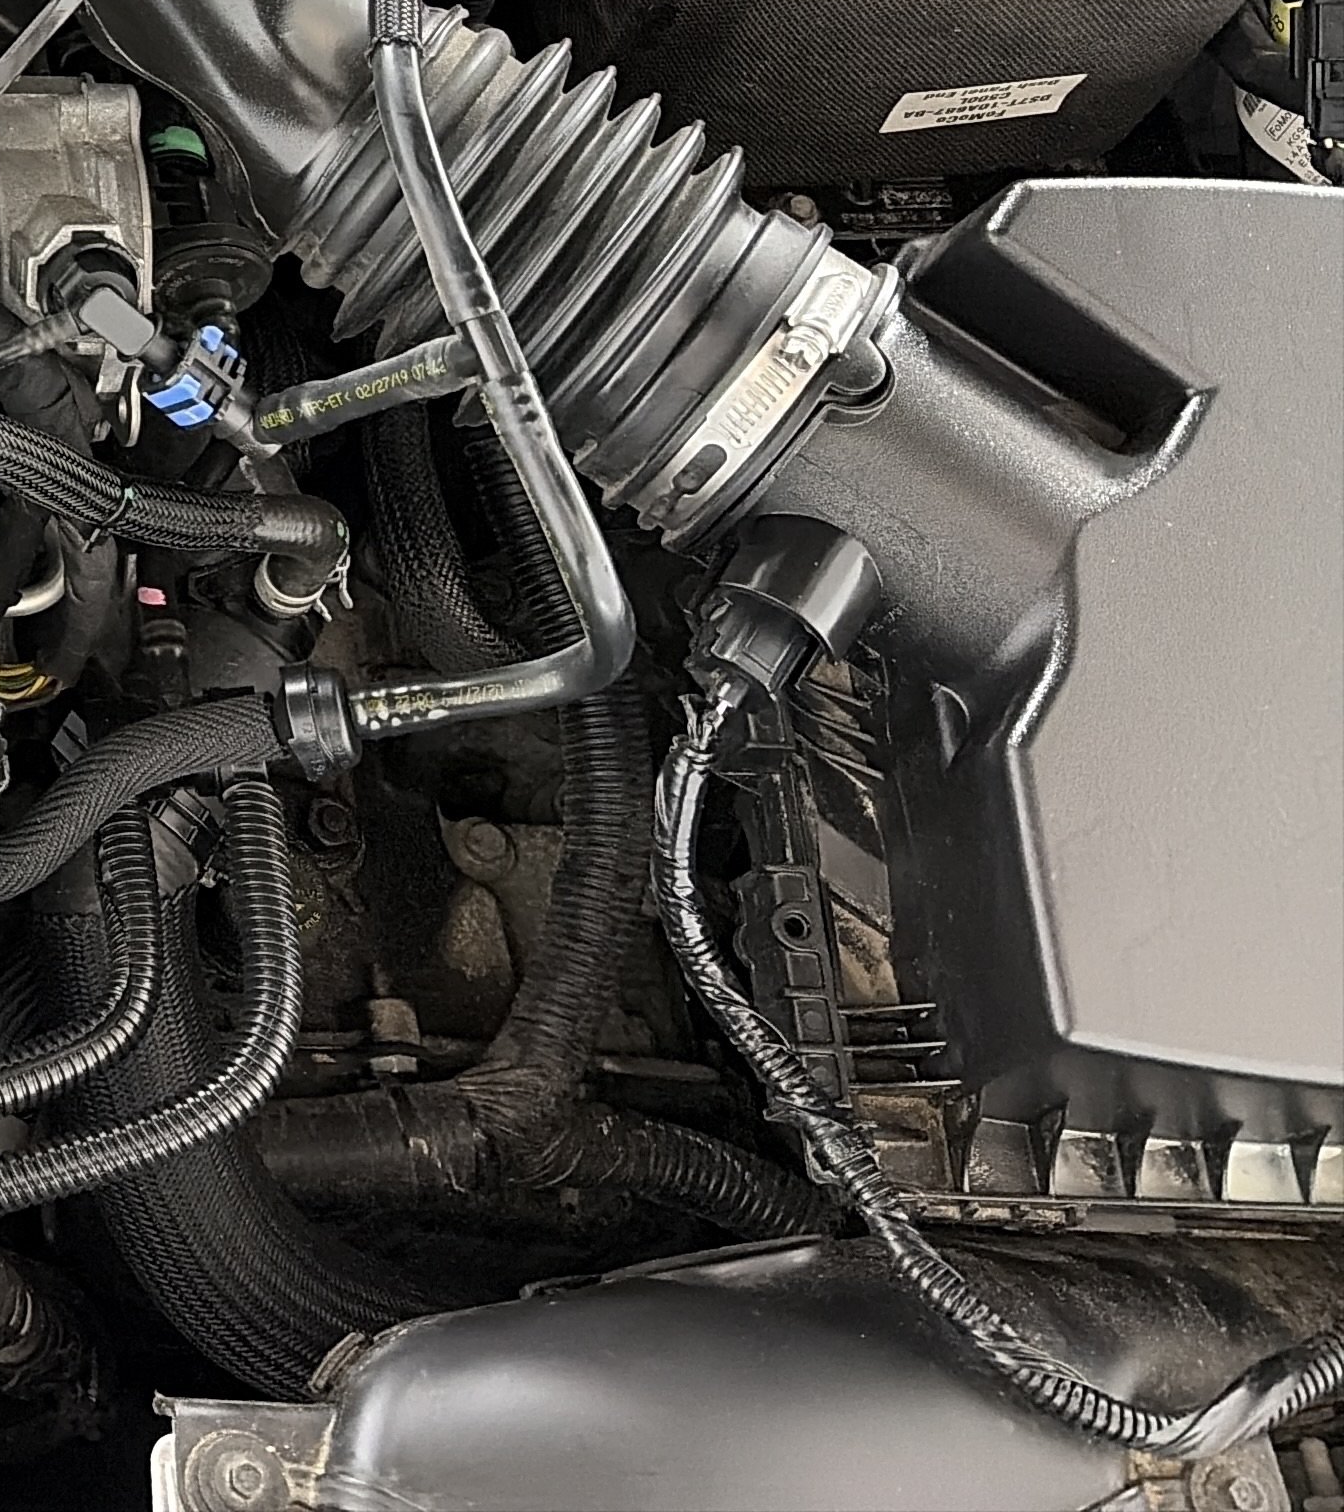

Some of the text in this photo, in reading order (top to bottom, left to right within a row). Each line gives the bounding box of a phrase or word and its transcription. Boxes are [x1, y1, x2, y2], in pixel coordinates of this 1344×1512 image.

[922, 78, 1059, 100] Dash Panel End
[935, 109, 1005, 124] FoMoCo
